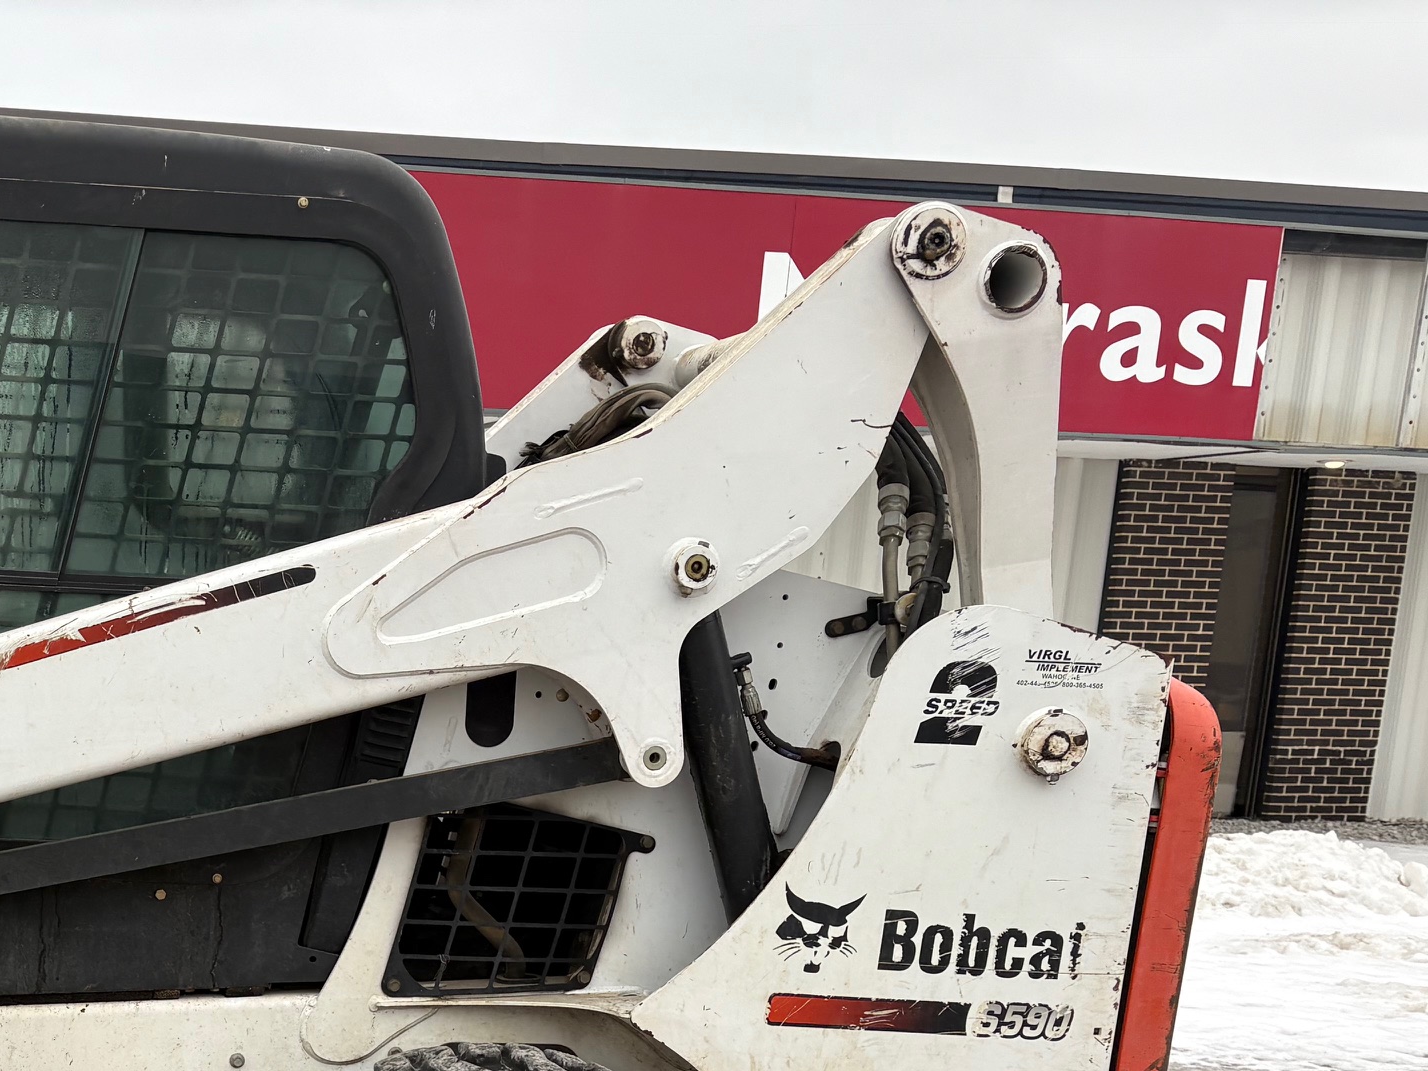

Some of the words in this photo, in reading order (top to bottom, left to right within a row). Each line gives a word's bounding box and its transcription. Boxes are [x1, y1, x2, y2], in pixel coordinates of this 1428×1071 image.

[1036, 663, 1101, 674] IMPLEMENT
[923, 698, 1000, 717] SPEED
[973, 1000, 1075, 1042] S590
